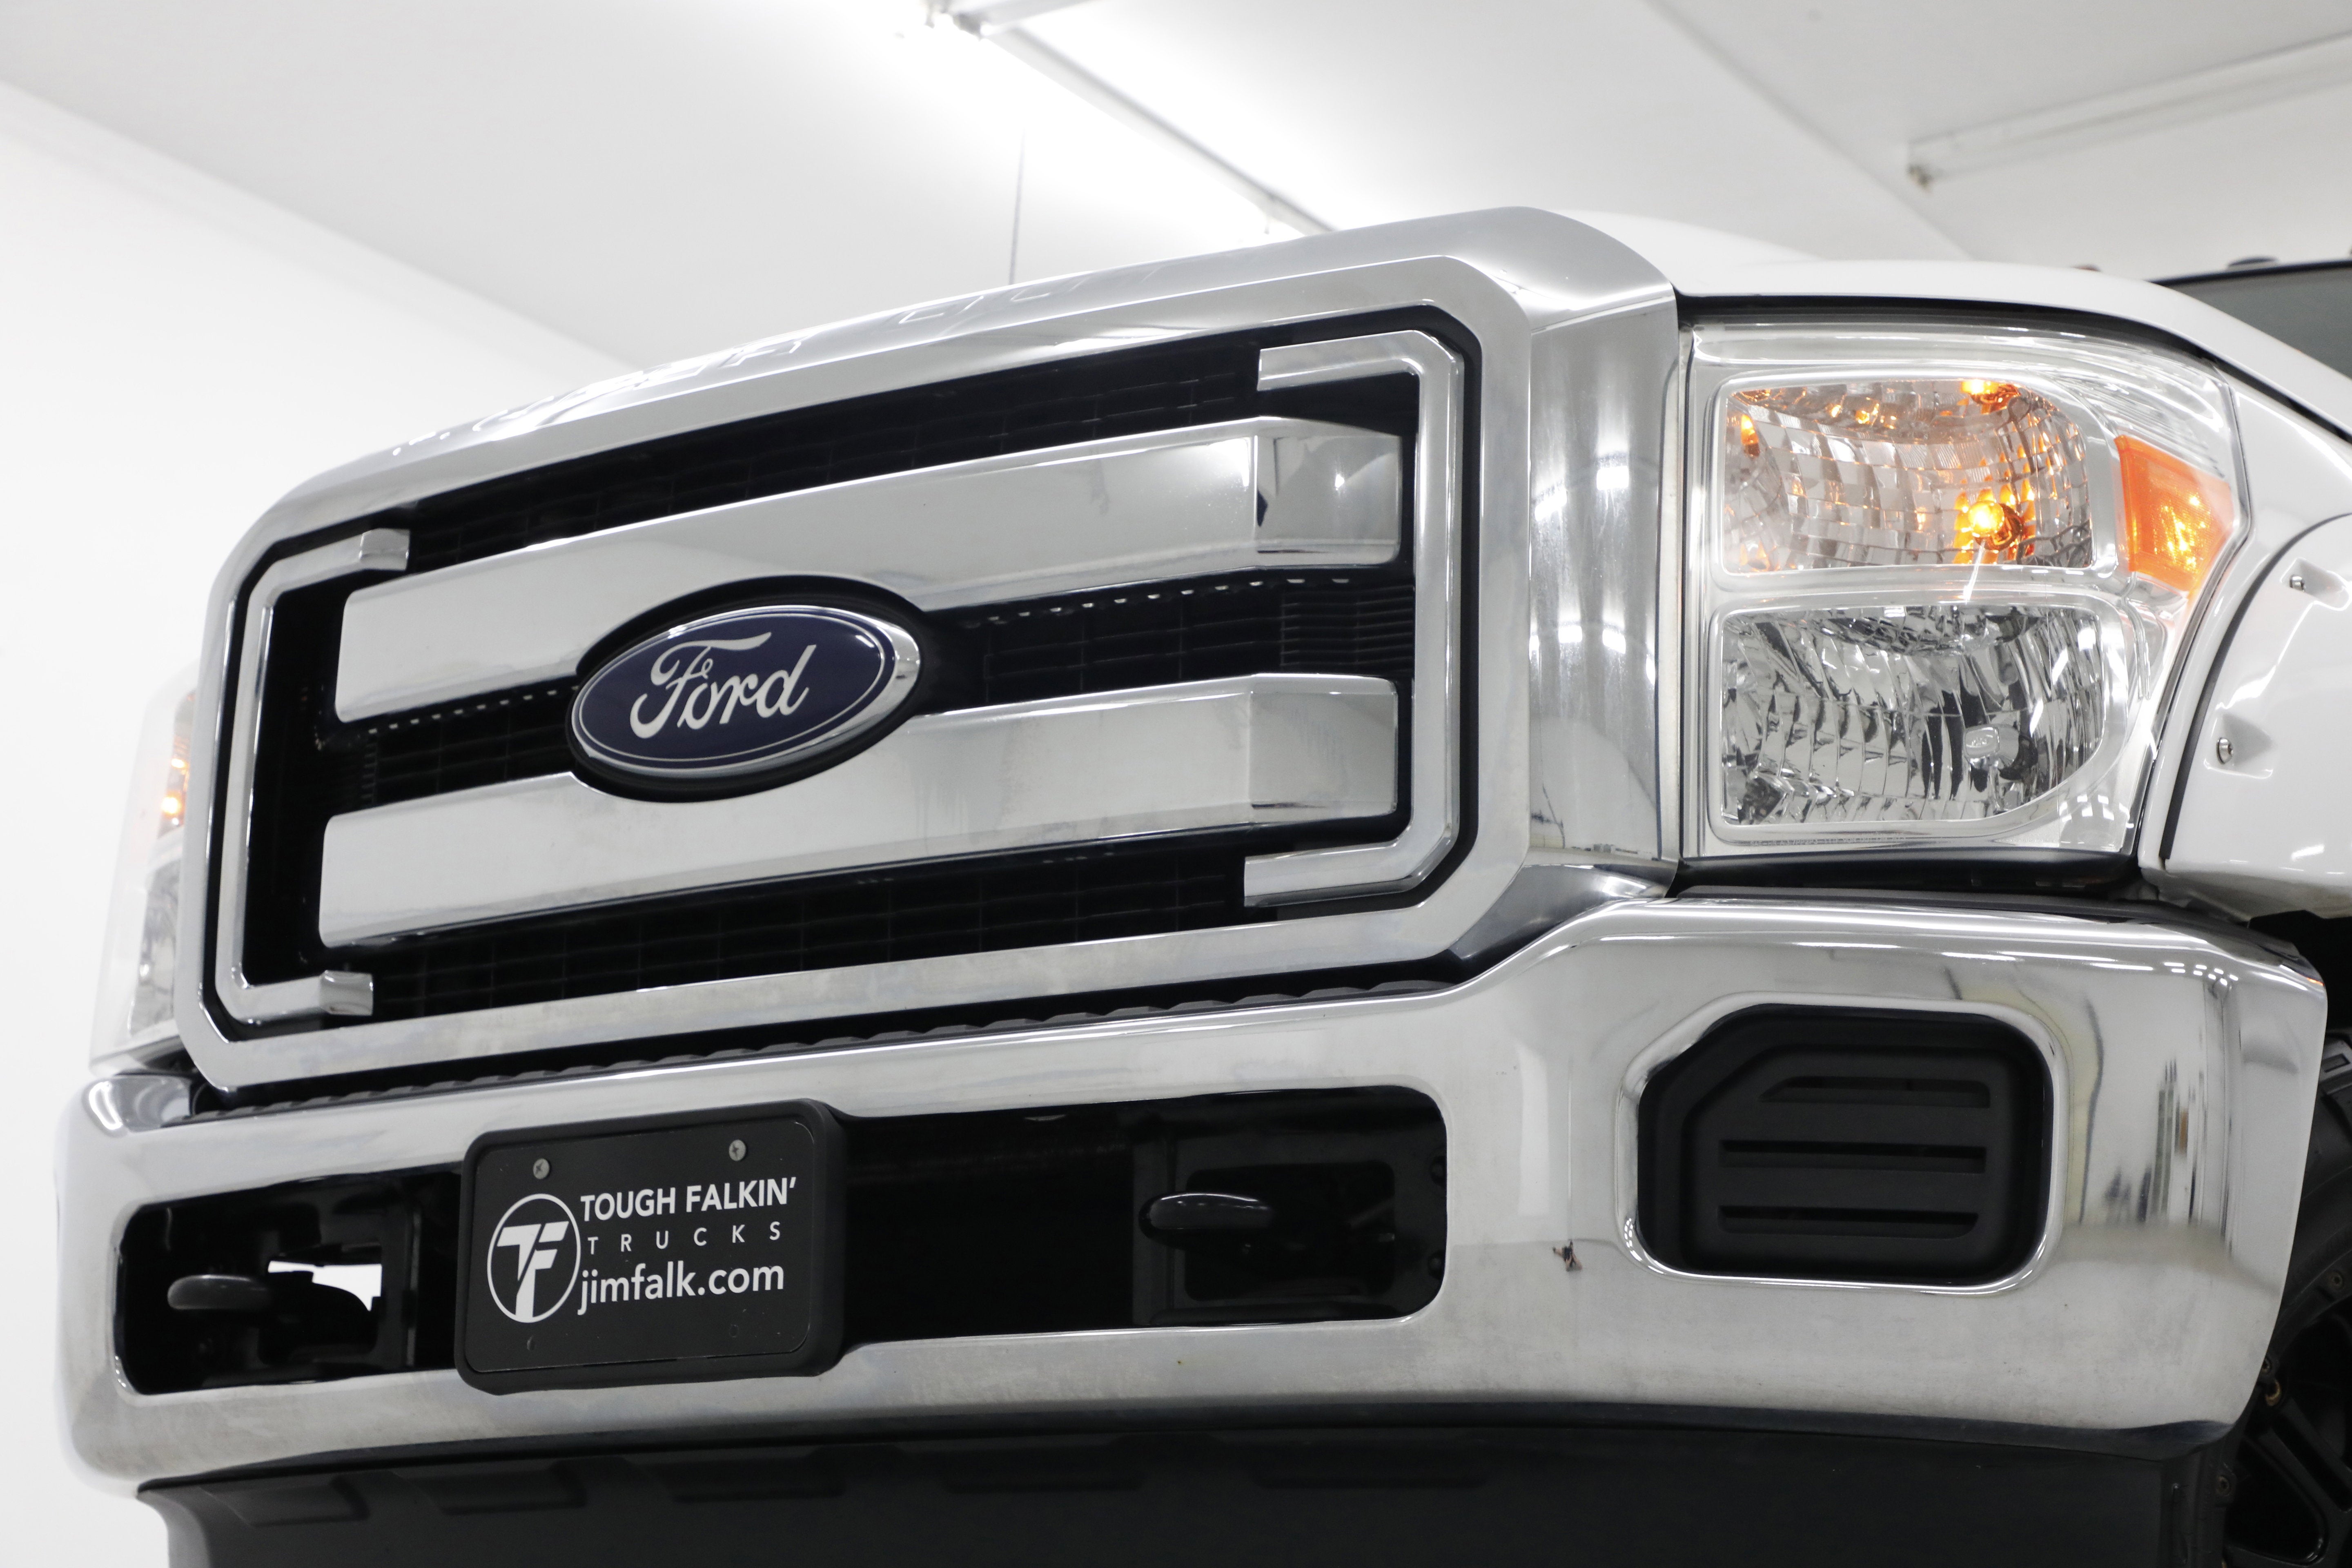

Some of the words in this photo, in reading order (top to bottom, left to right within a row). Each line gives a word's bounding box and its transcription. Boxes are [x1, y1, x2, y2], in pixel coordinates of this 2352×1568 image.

[630, 632, 816, 738] Ford
[580, 1187, 676, 1222] TOUGH
[686, 1176, 796, 1213] FALKIN'
[587, 1221, 780, 1255] TRUCKS
[577, 1260, 784, 1316] jimfalk.com
